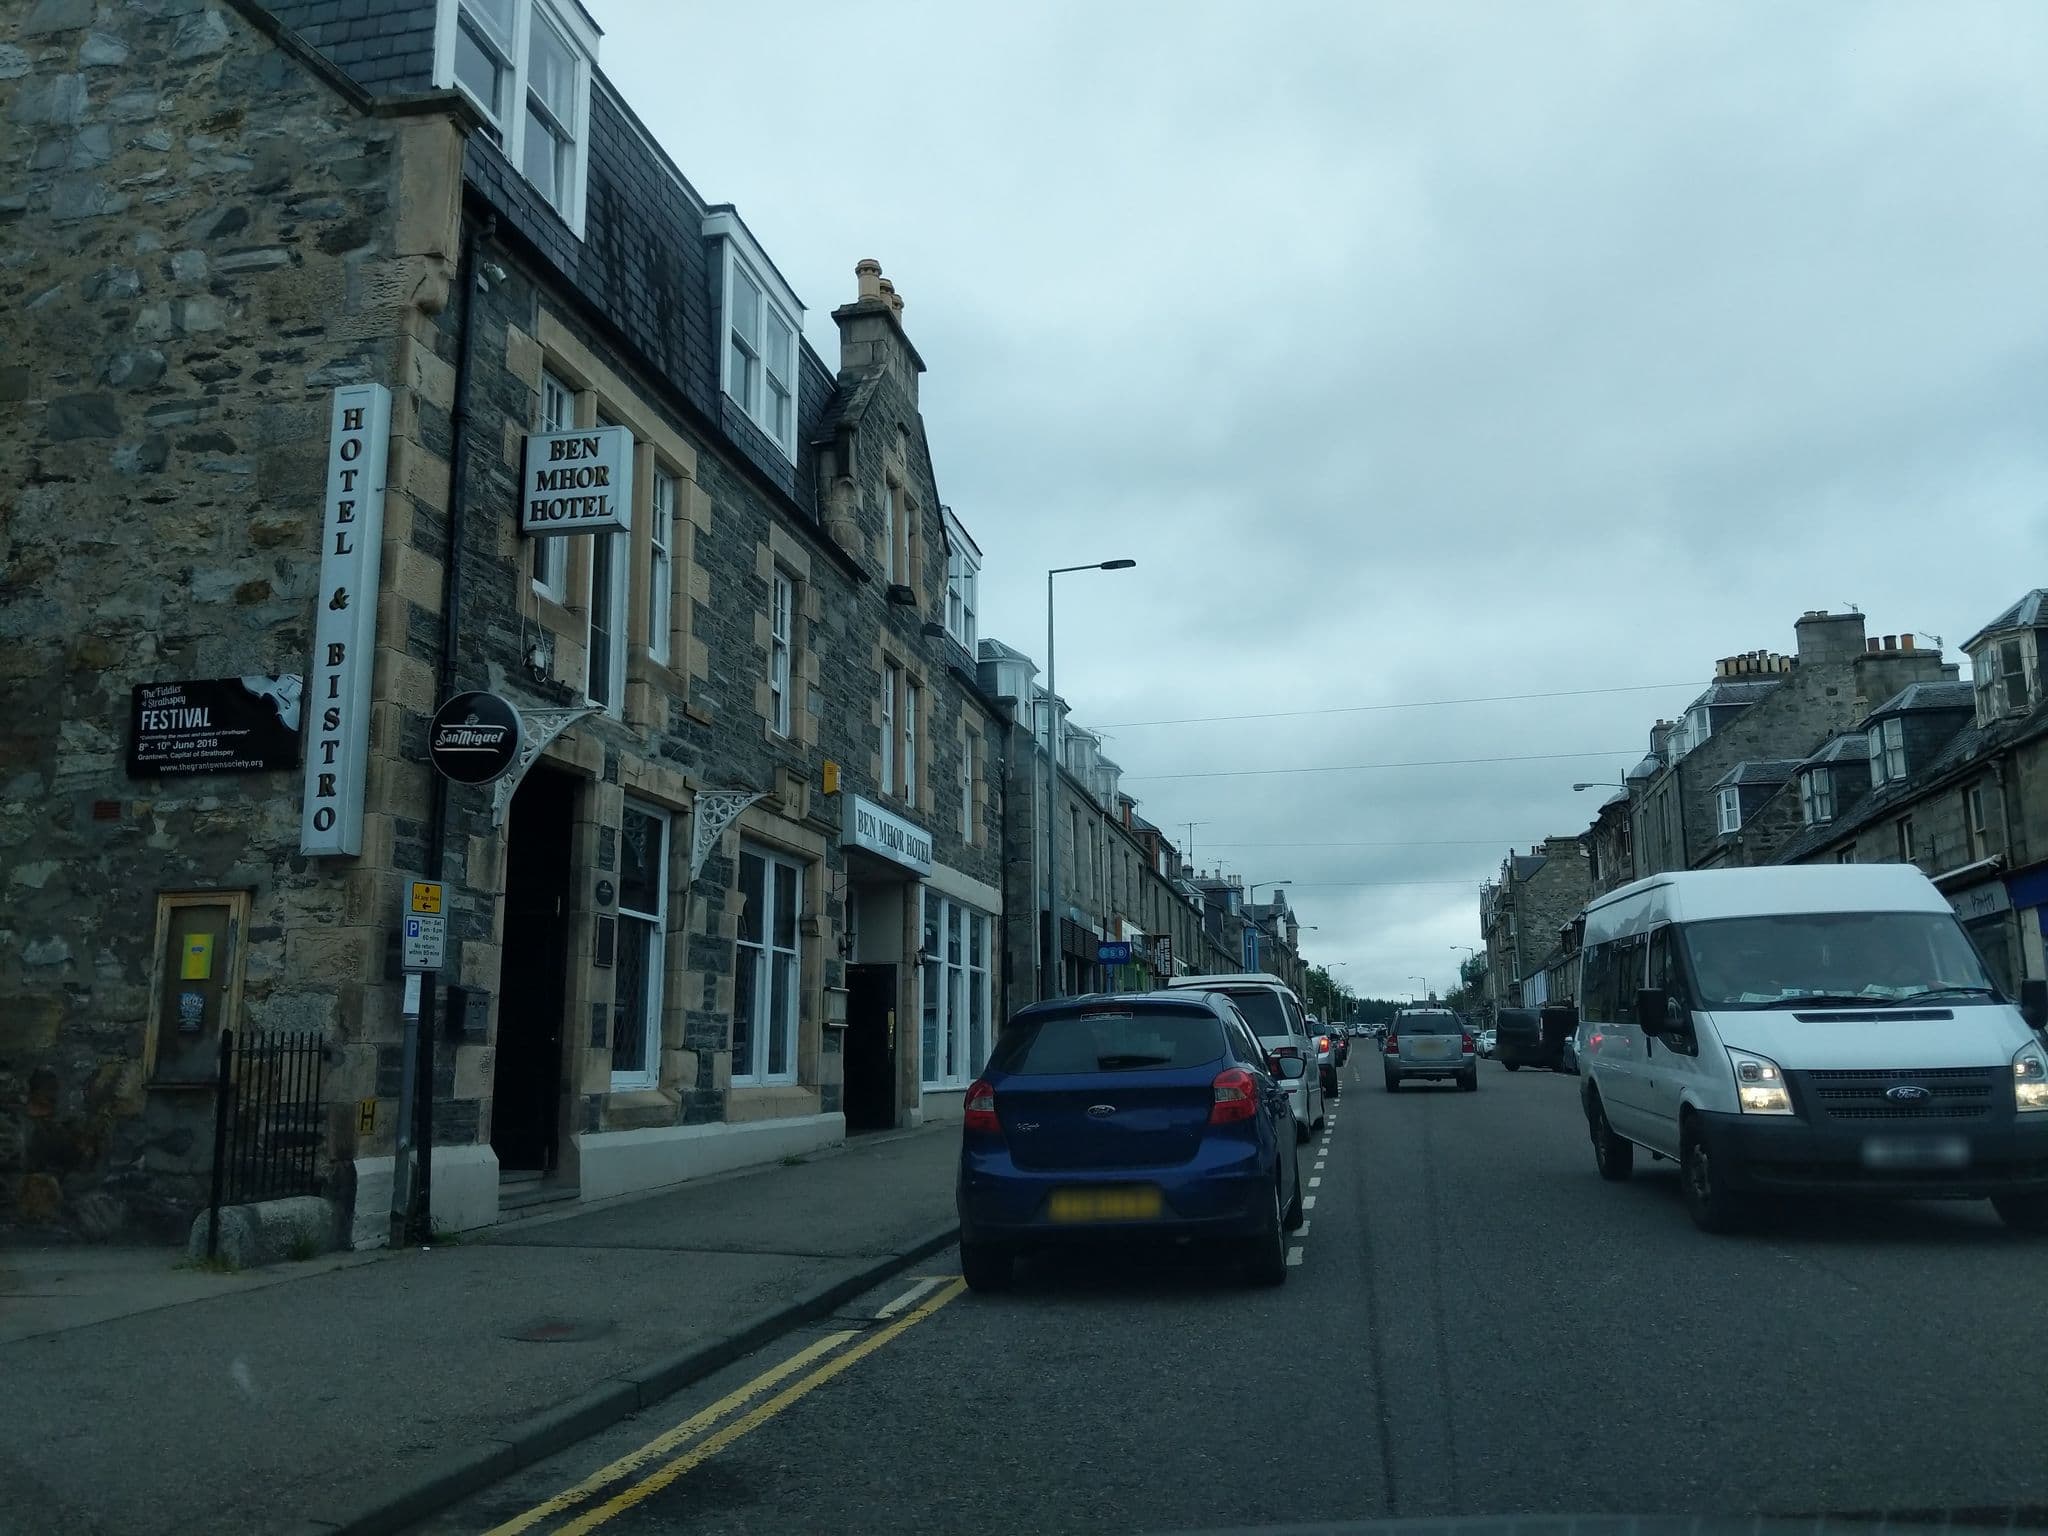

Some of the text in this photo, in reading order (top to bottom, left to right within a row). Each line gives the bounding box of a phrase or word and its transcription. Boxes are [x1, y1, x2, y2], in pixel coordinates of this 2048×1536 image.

[549, 437, 601, 461] BEN
[535, 465, 610, 492] MHOR
[529, 495, 614, 521] HOTEL
[313, 407, 363, 832] HOTEL & BISTRO
[141, 685, 182, 699] The Fiddler
[147, 695, 186, 708] Strathspey
[141, 707, 212, 731] FESTIVAL
[173, 740, 195, 750] June
[196, 738, 218, 748] 2018
[201, 749, 235, 758] Strathspey
[857, 808, 931, 865] BEN MHOR HOTEL
[409, 921, 418, 936] P
